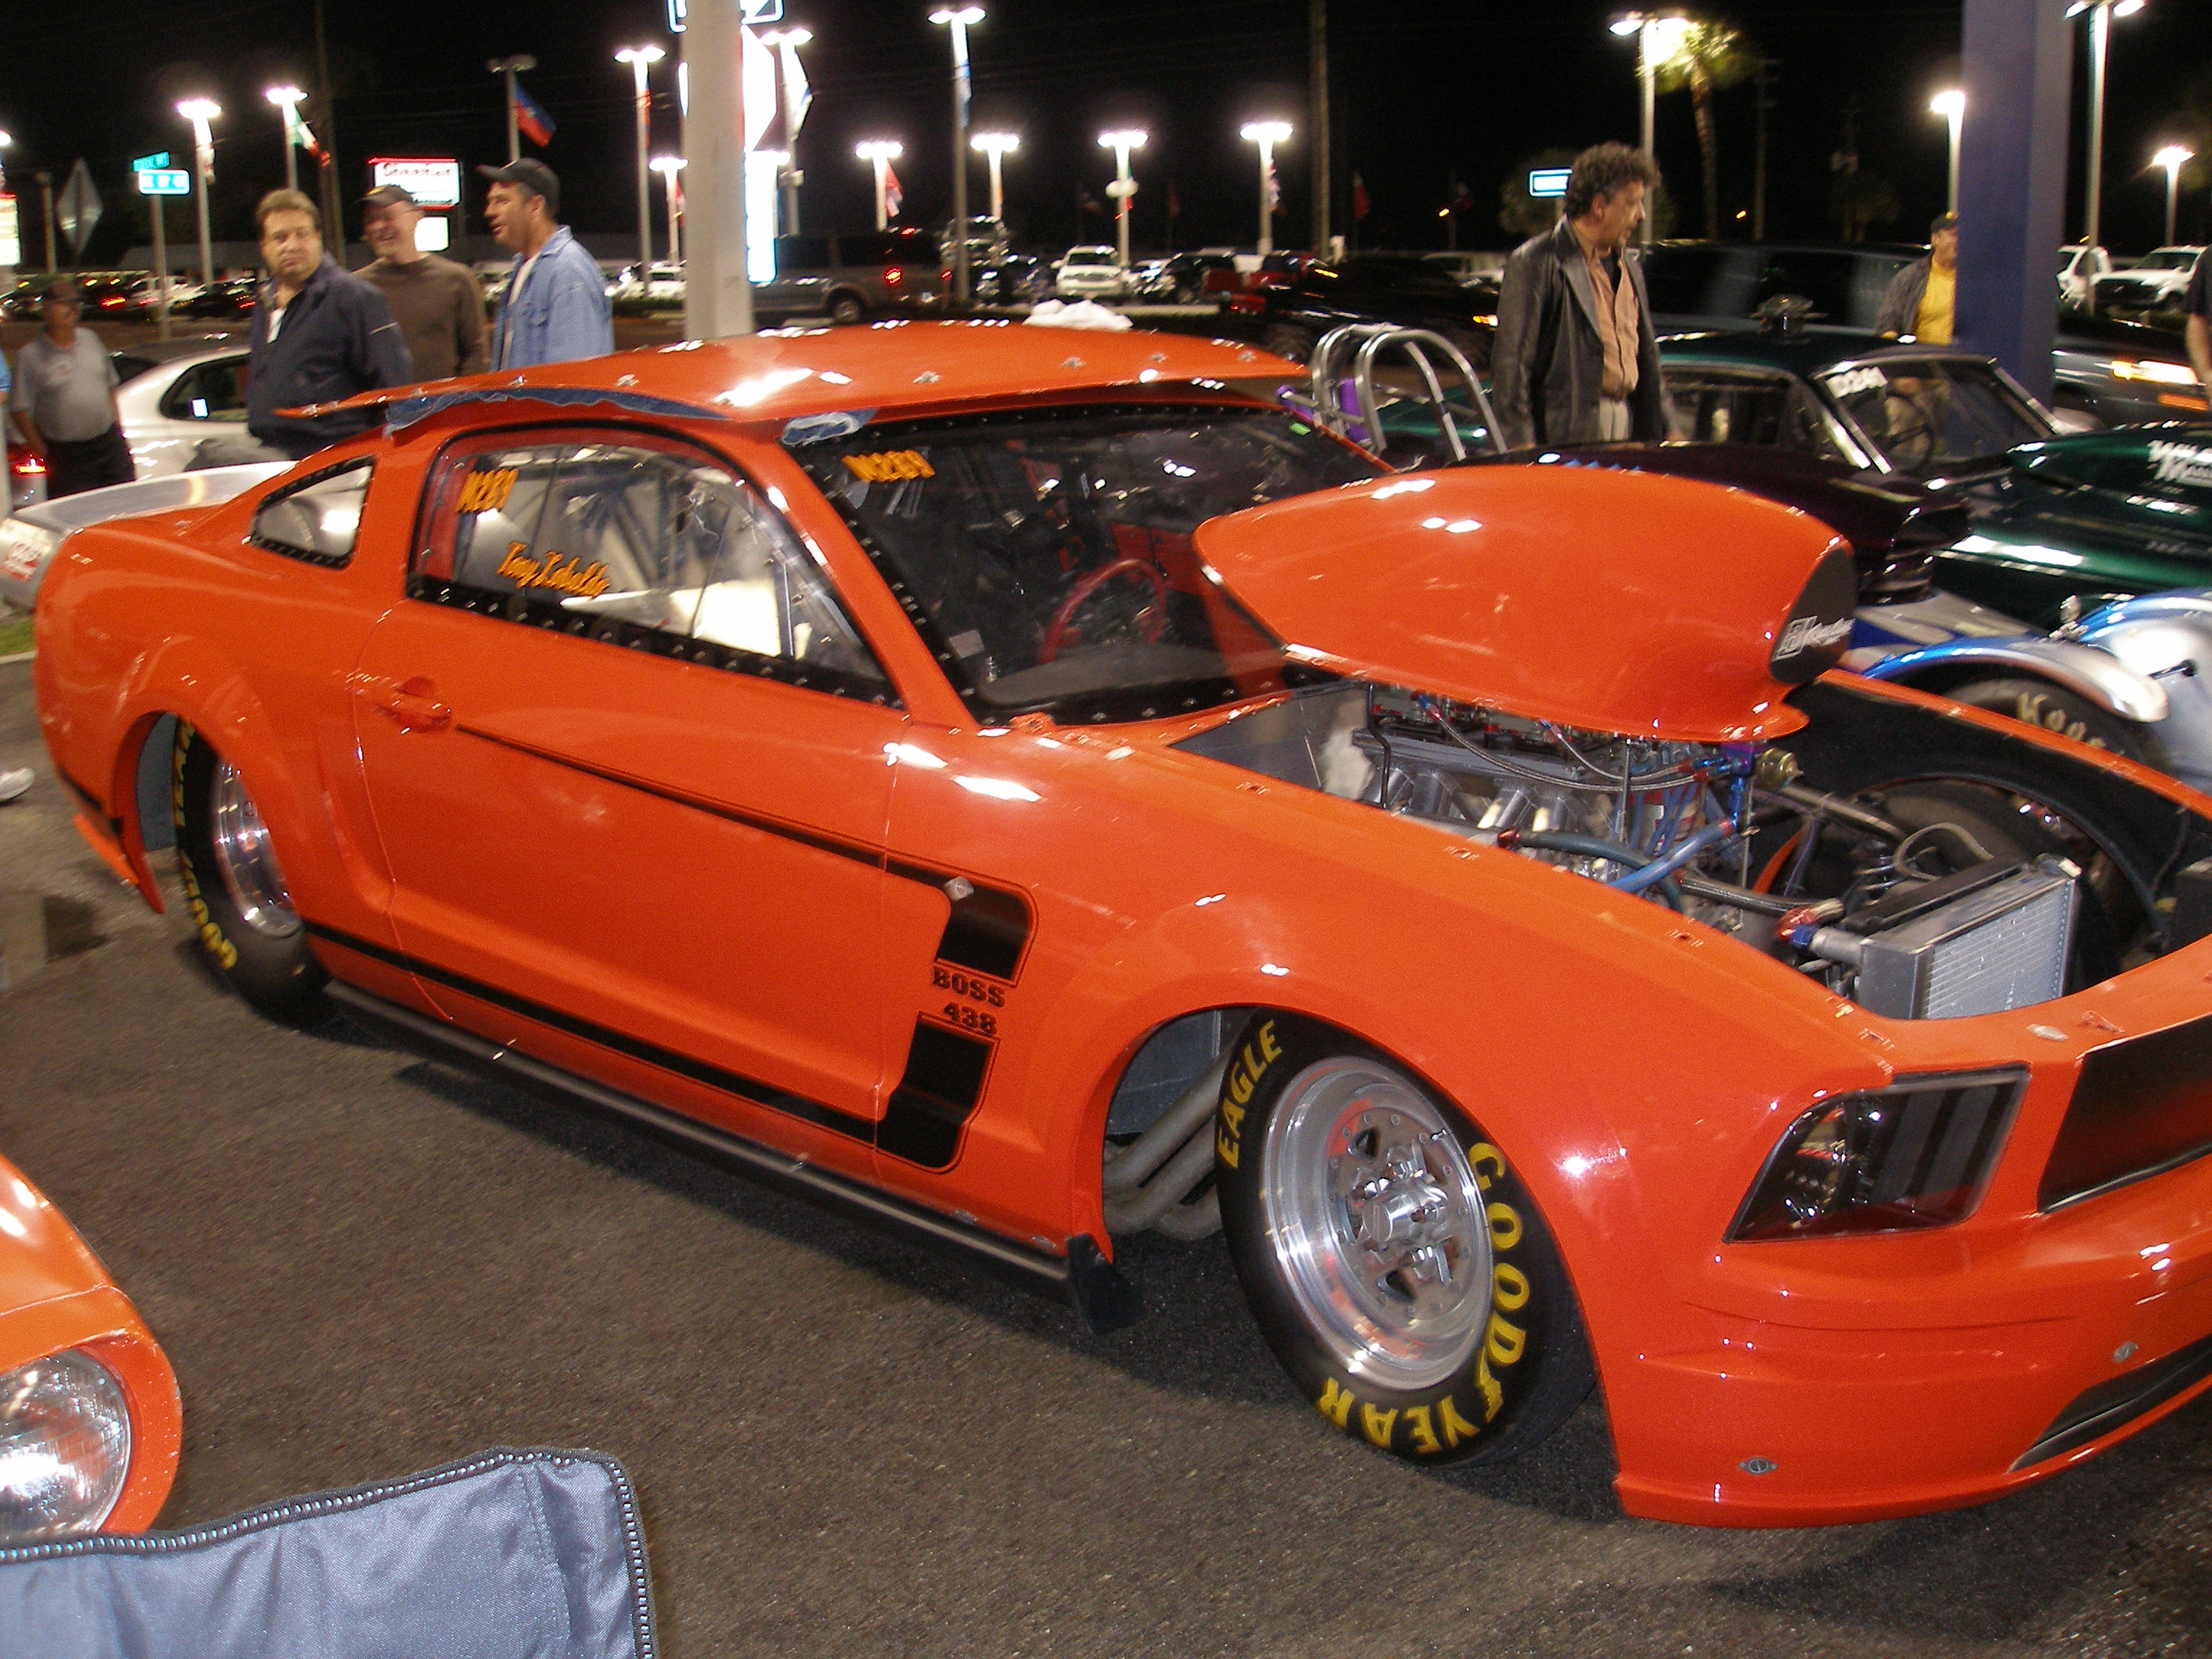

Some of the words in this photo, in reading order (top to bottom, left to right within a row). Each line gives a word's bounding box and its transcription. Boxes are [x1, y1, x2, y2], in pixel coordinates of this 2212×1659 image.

[932, 965, 1006, 1008] BOSS
[943, 1002, 997, 1035] 438
[1217, 1019, 1282, 1168] EAGLE
